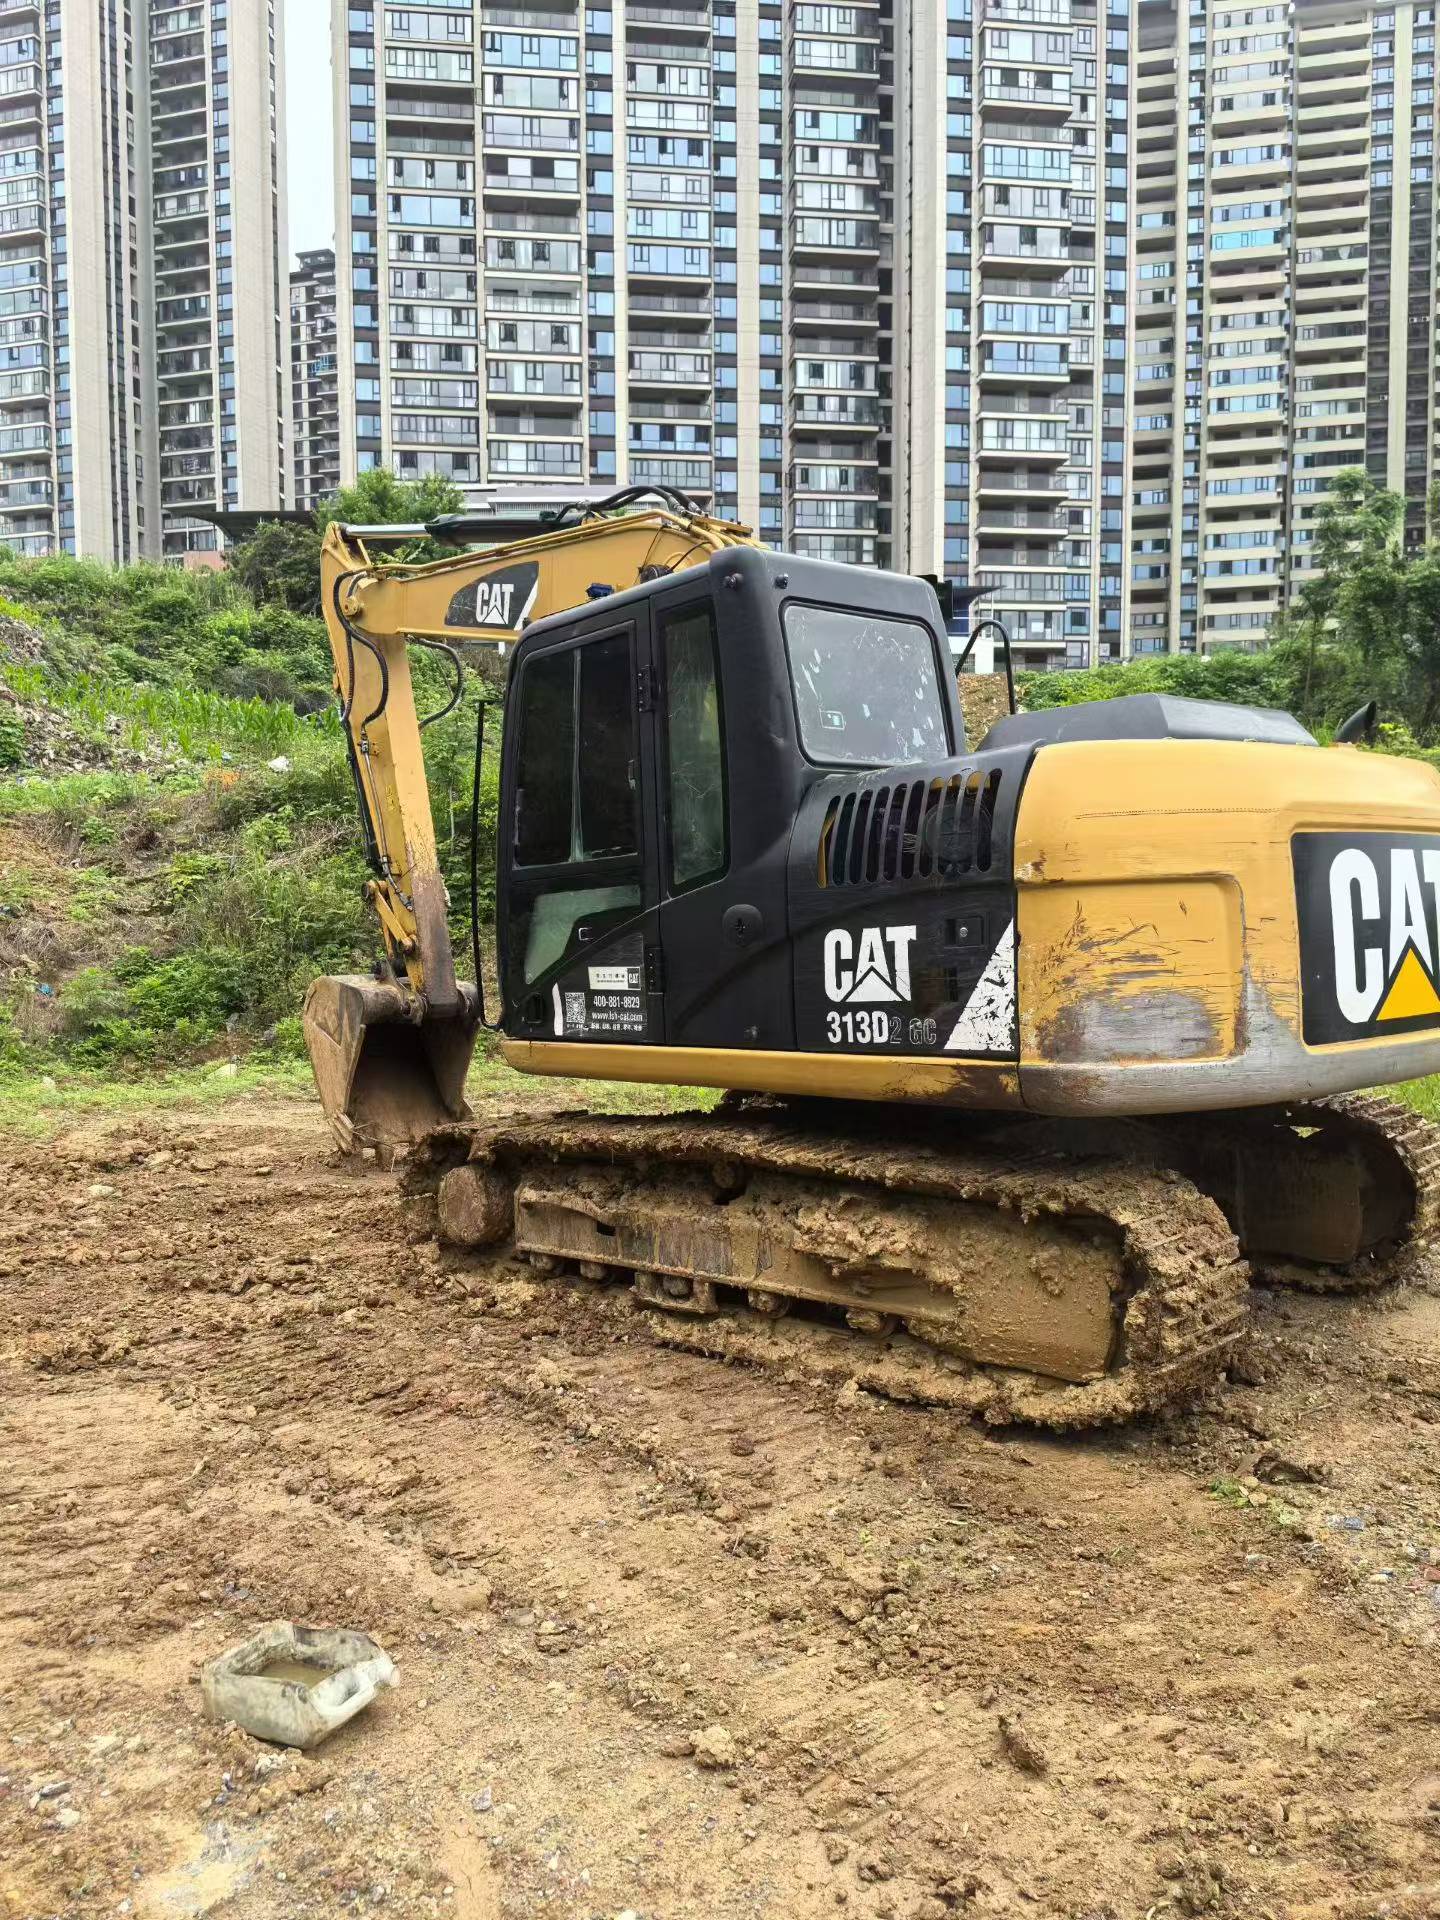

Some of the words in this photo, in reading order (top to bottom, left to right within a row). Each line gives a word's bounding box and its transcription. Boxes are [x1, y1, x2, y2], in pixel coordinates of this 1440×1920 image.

[476, 582, 514, 625] CAT
[628, 973, 640, 984] CAT
[824, 925, 917, 1002] CAT
[909, 1018, 937, 1045] GC
